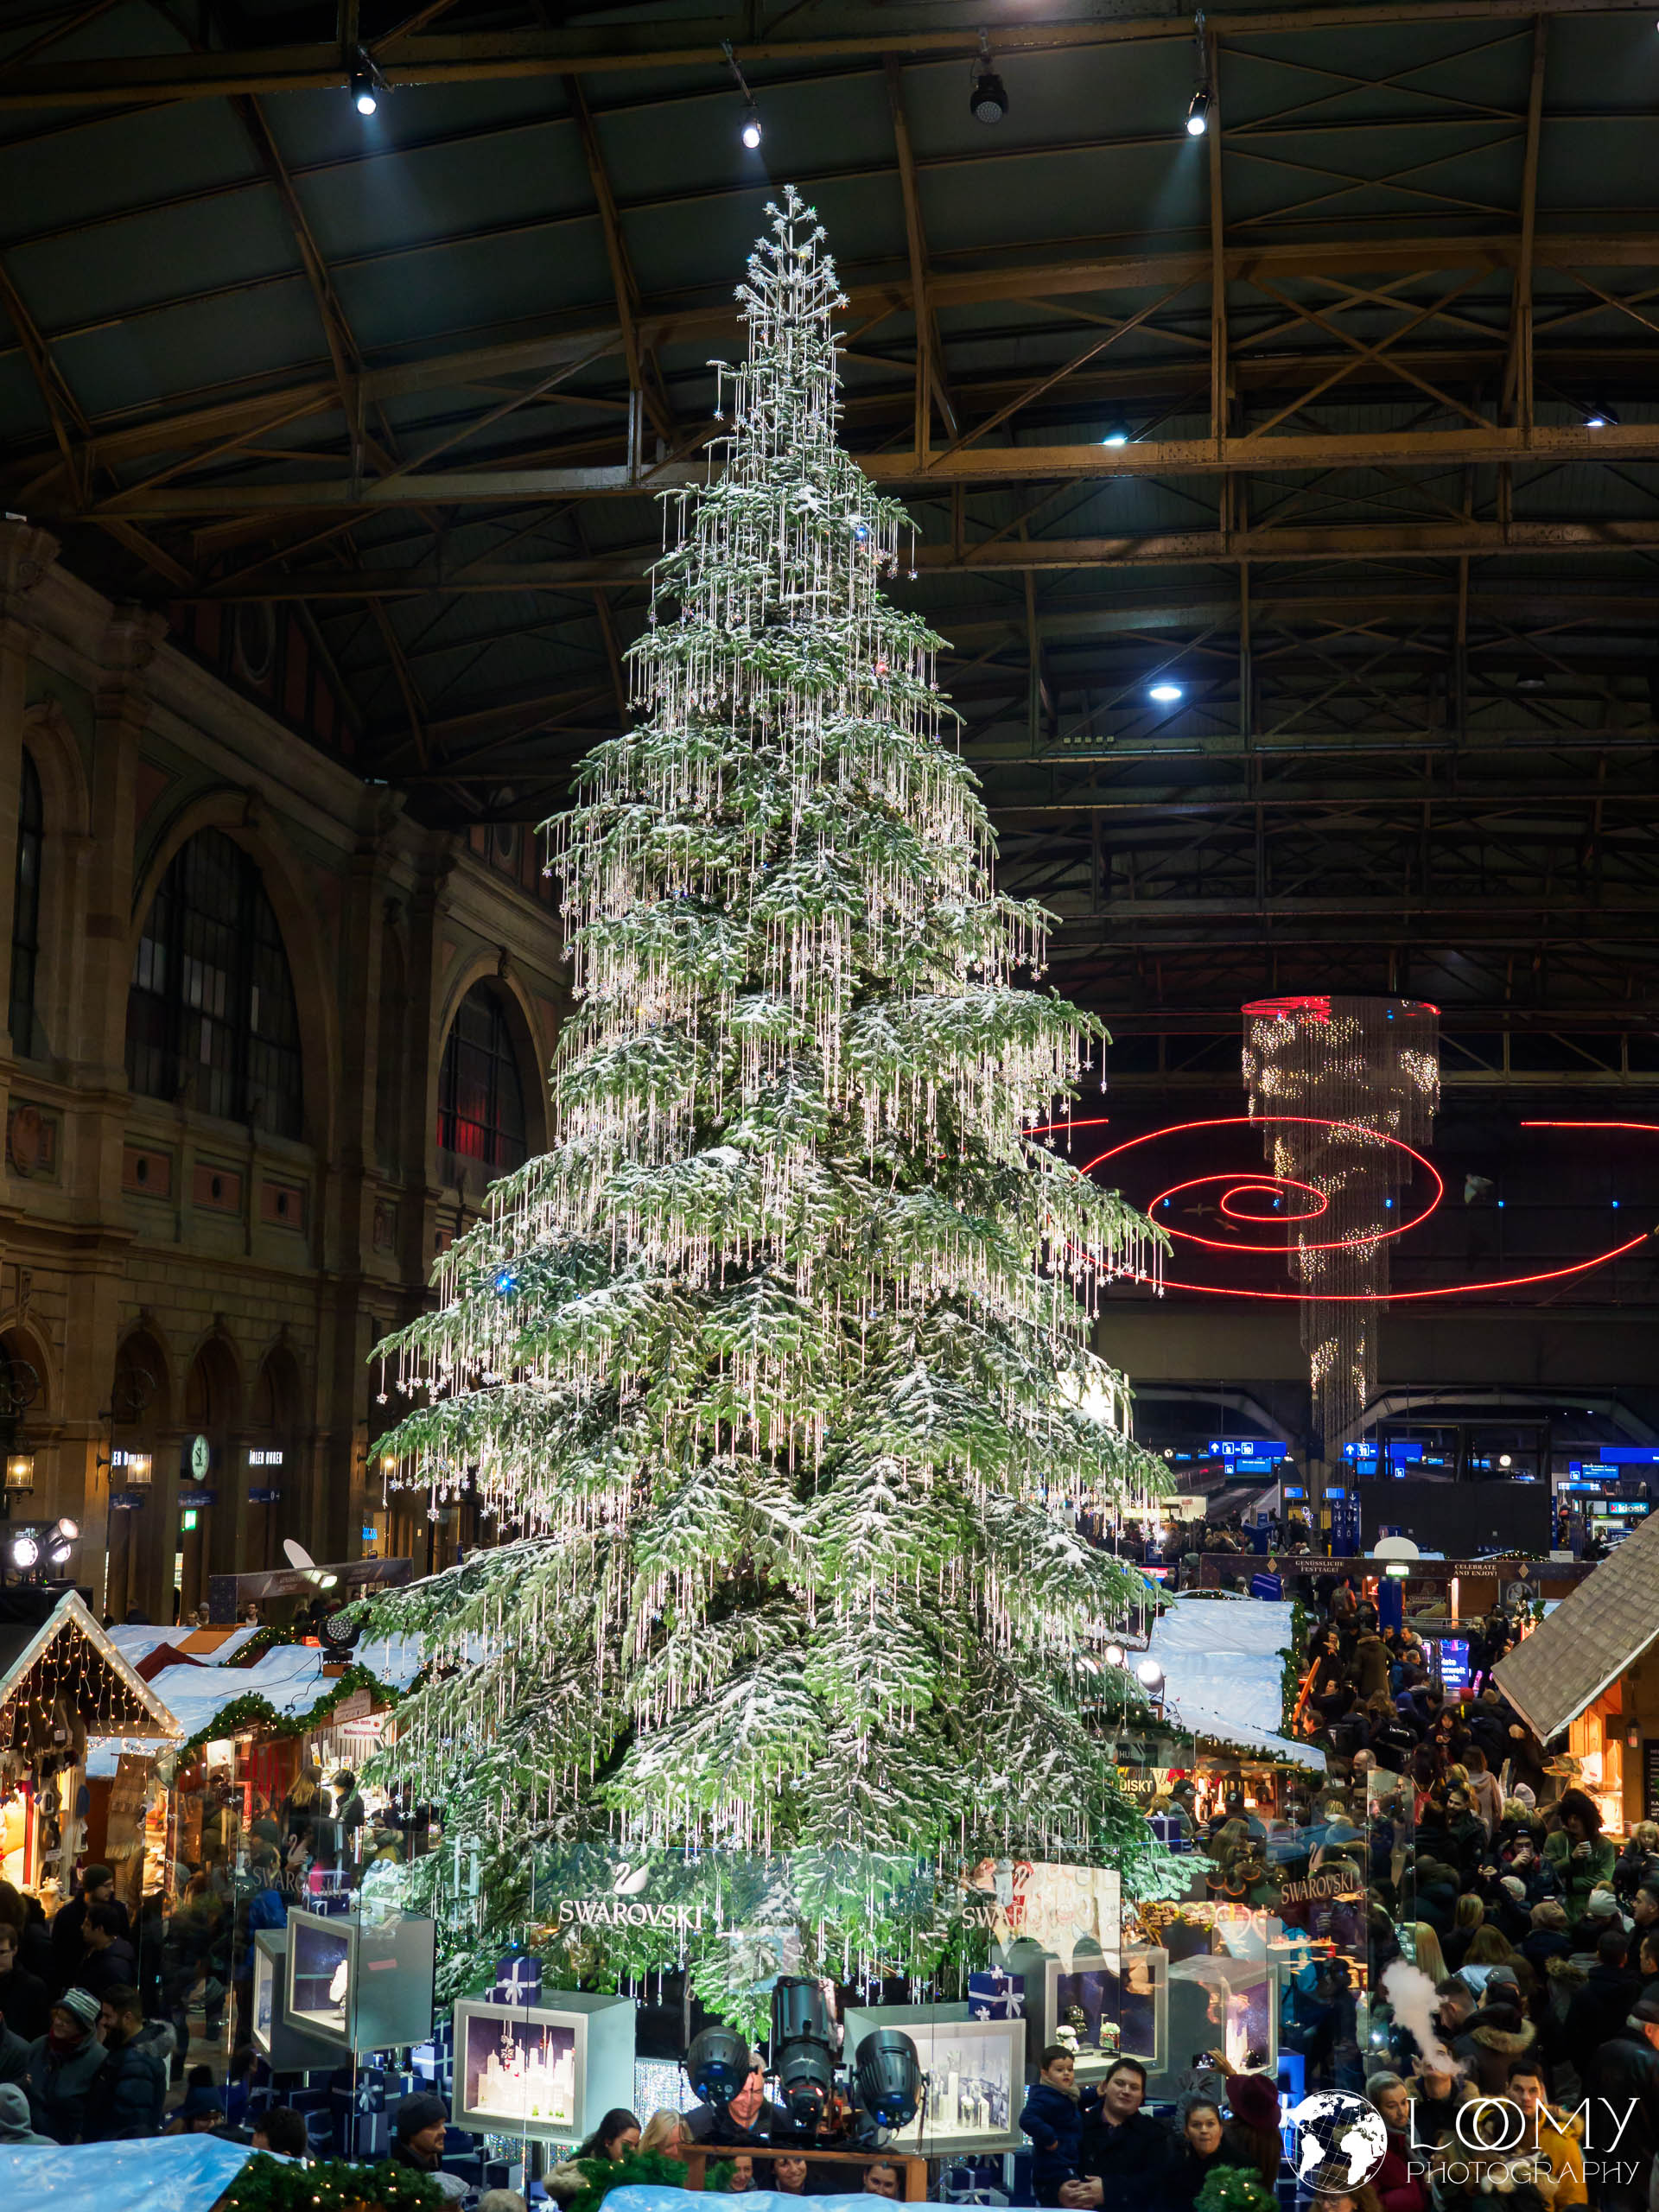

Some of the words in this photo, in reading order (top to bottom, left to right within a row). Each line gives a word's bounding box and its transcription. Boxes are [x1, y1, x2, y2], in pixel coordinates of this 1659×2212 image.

[1618, 1503, 1646, 1513] kiosk
[1281, 1871, 1355, 1905] SWAROVSKI
[559, 1900, 702, 1929] SWAROVSKI
